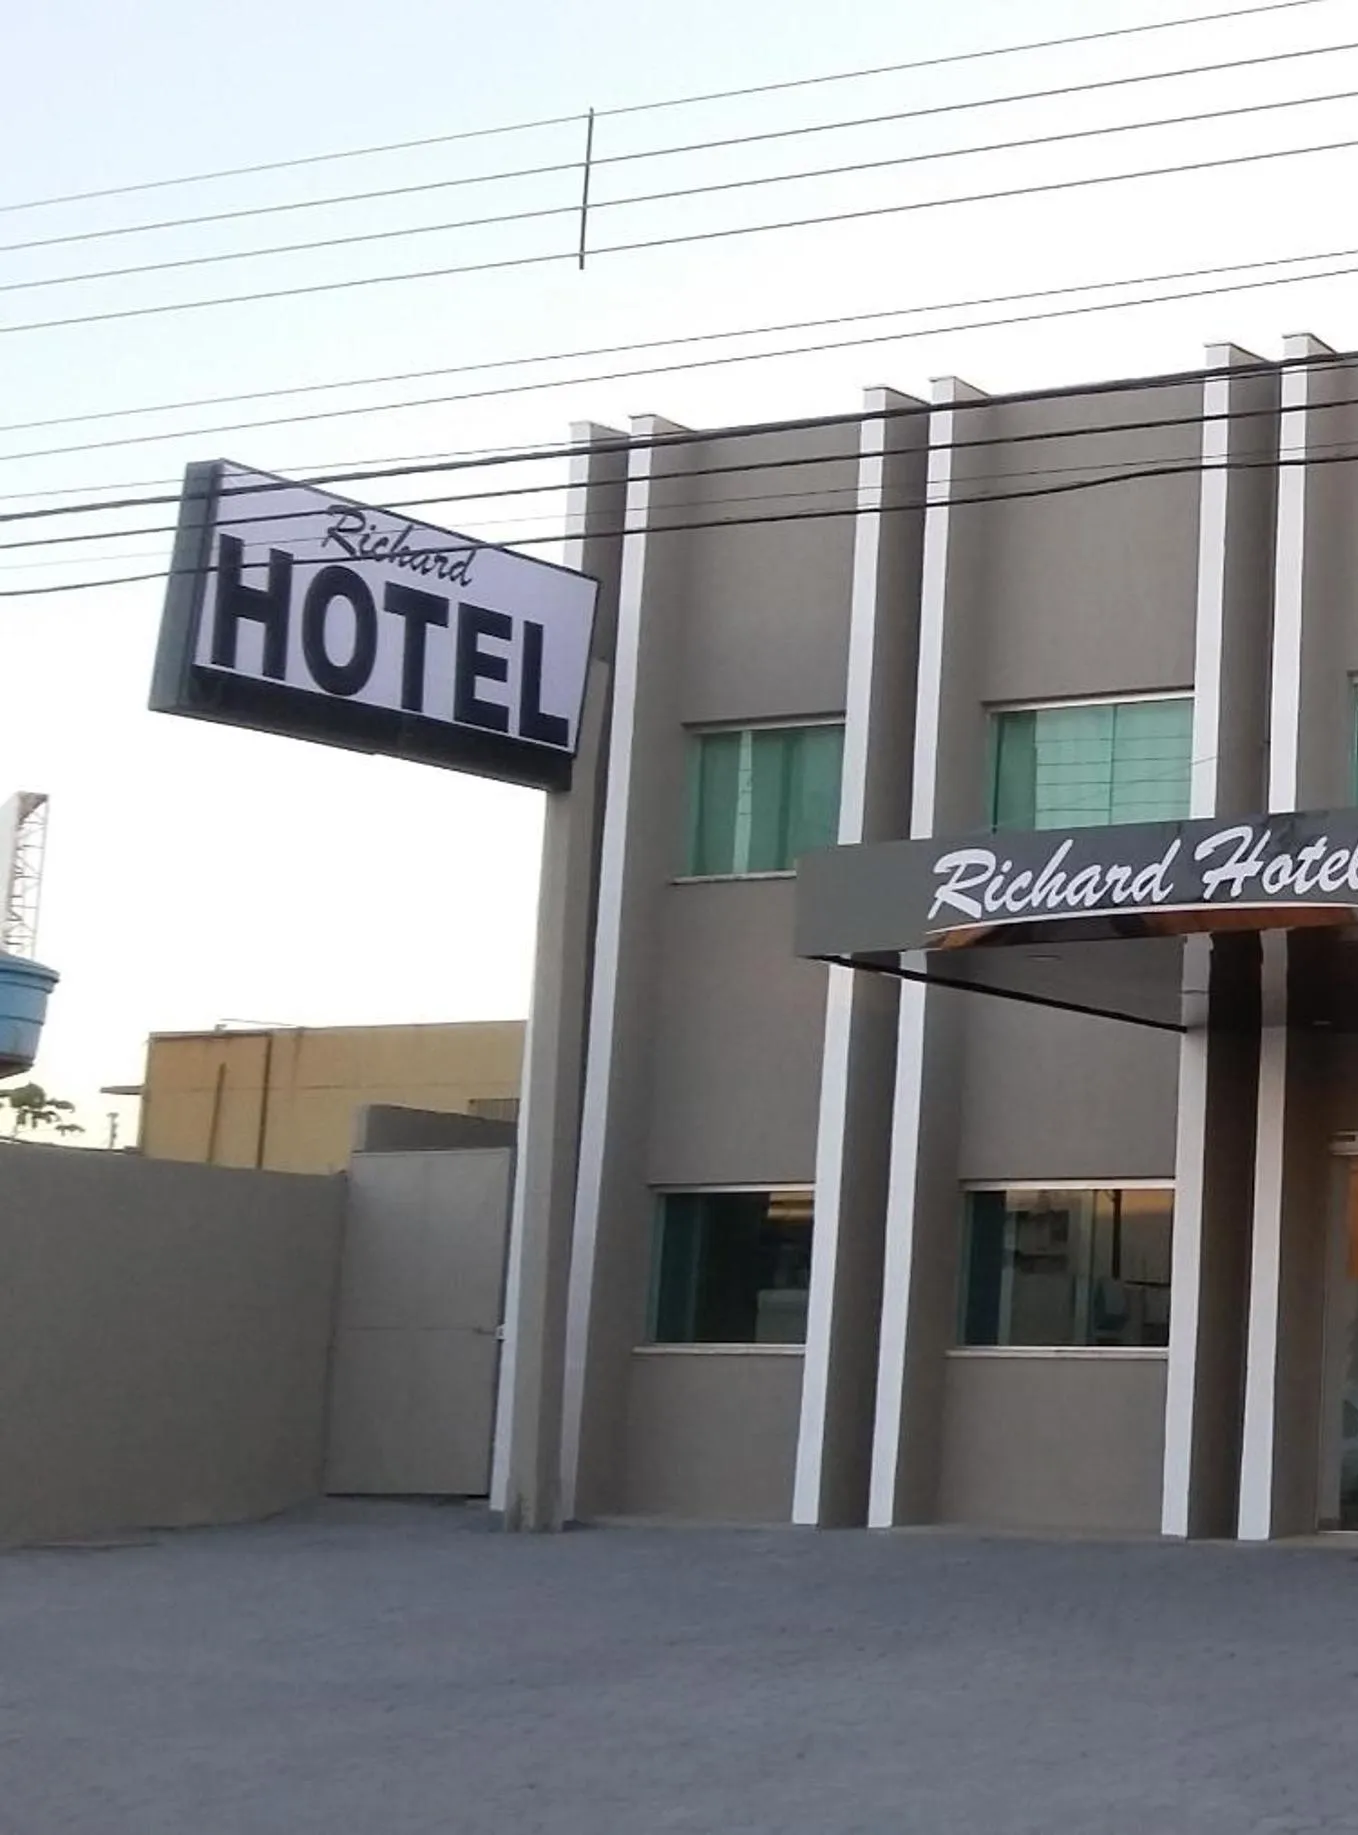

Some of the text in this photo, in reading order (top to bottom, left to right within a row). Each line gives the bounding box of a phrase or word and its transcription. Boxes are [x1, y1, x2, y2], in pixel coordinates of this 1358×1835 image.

[321, 505, 473, 586] Richard
[210, 534, 569, 747] HOTEL
[927, 839, 1182, 920] Richard
